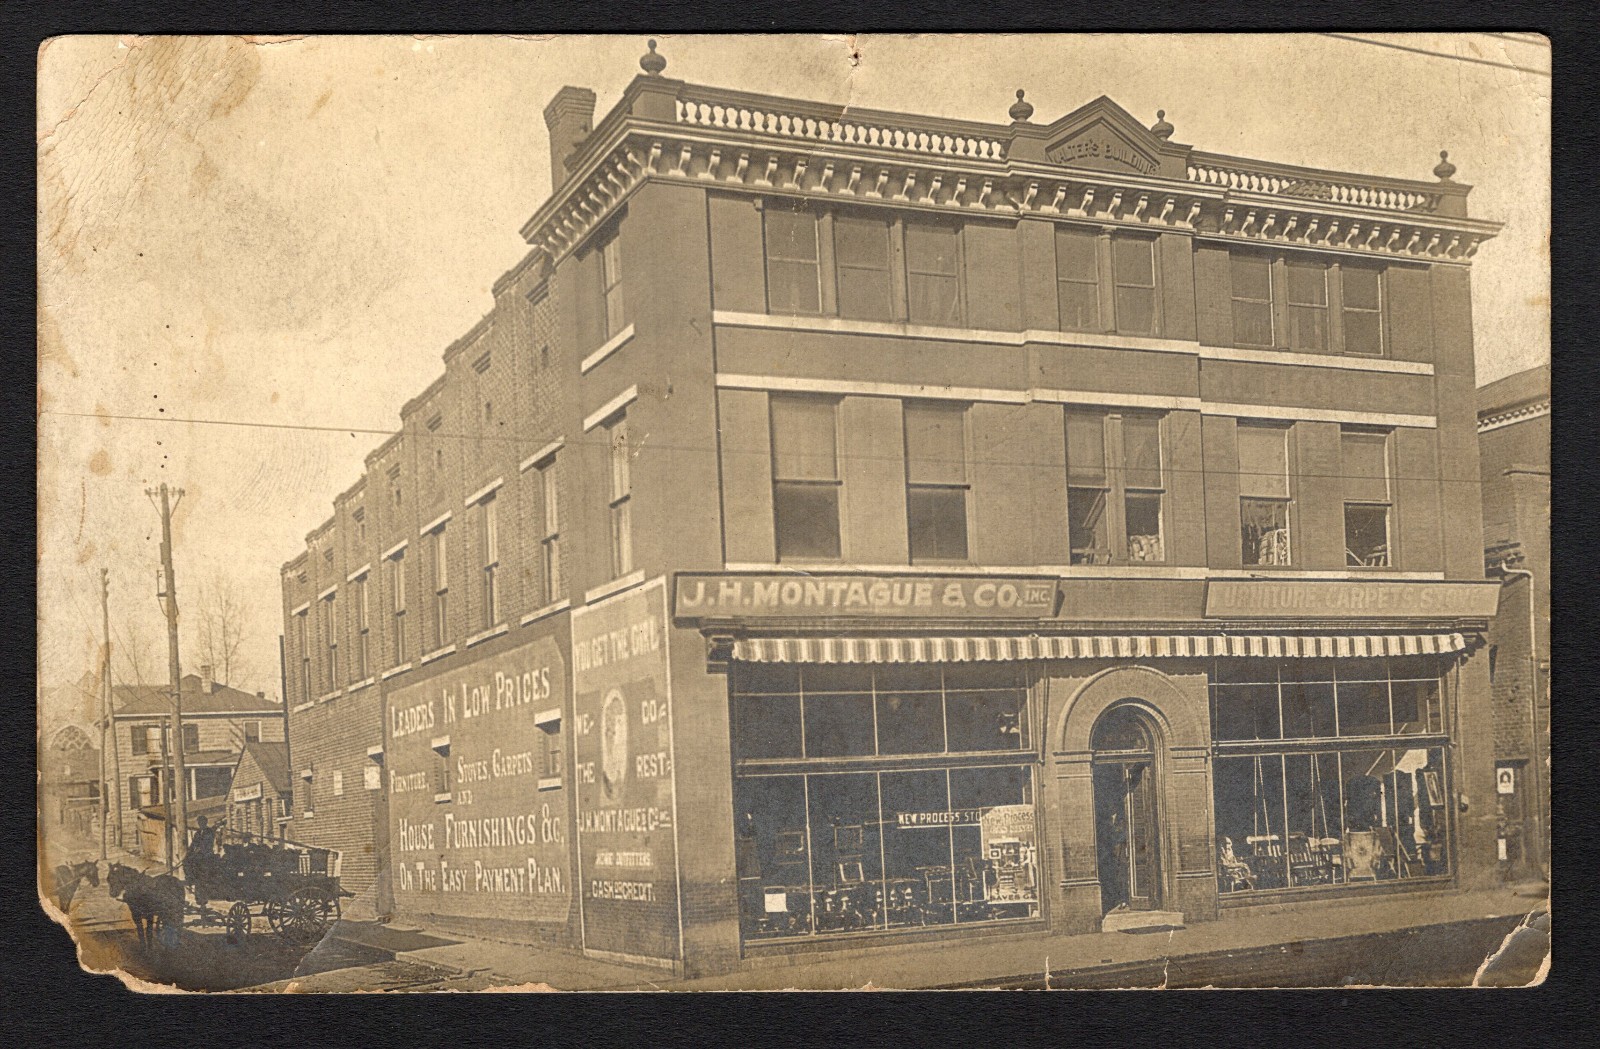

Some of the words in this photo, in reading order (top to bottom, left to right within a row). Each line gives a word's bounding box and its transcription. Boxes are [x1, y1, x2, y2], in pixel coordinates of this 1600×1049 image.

[942, 583, 966, 608] &
[973, 583, 1023, 608] CO.
[592, 633, 608, 668] GET
[610, 628, 629, 662] THE
[391, 701, 434, 738] LEADERS
[443, 689, 456, 724] IN
[462, 683, 490, 718] LOW
[495, 667, 550, 710] PRICES
[576, 761, 595, 784] THE
[636, 751, 667, 778] REST
[399, 818, 435, 851] HOUSE
[445, 813, 536, 849] FURNISHINGS
[898, 813, 918, 825] NEW
[920, 812, 960, 824] PROCESS
[400, 862, 413, 891] ON
[416, 861, 437, 891] THE
[441, 861, 467, 892] EASY
[474, 860, 524, 893] PAYMENT
[527, 857, 566, 894] PLAN.
[592, 880, 614, 899] CASH
